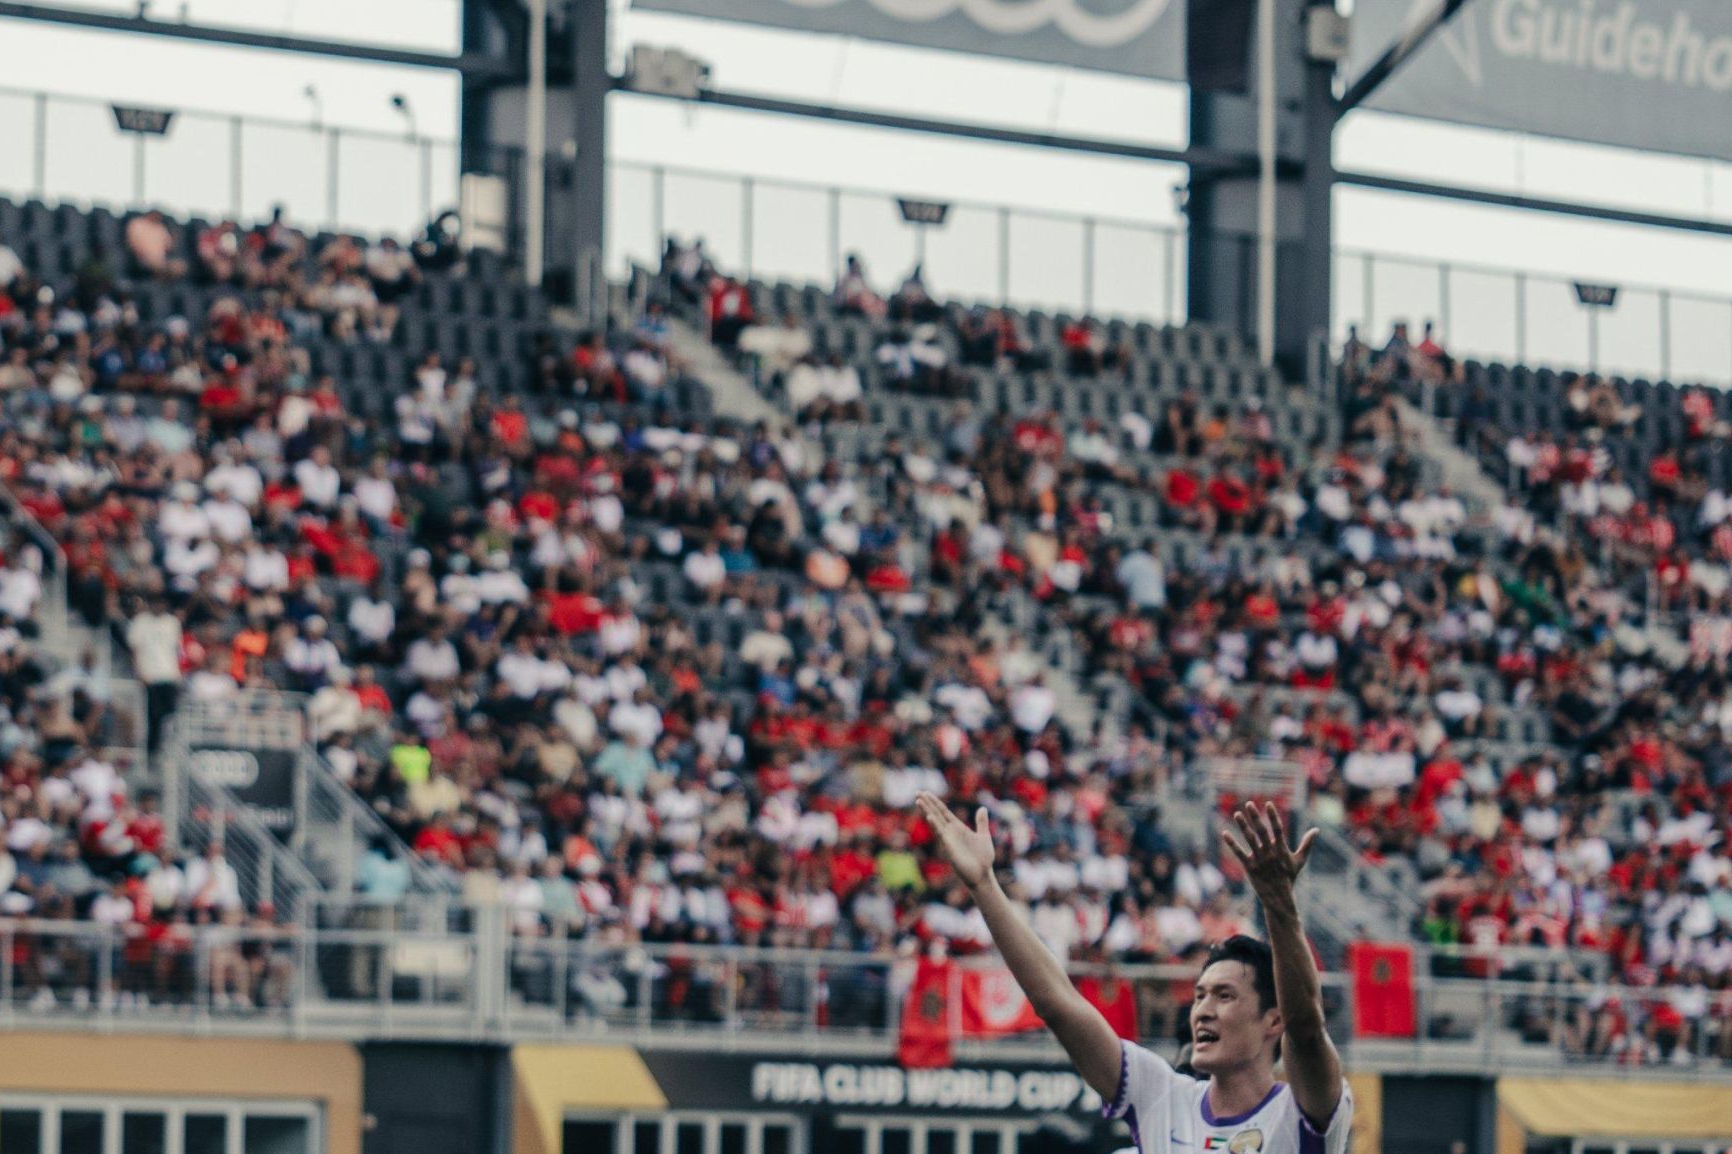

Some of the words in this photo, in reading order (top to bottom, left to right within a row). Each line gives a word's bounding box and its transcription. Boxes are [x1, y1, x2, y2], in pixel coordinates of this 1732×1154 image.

[752, 1062, 821, 1102] FIFA
[823, 1064, 905, 1105] CLUB
[907, 1069, 1016, 1109] WORLD
[1018, 1071, 1082, 1110] CUP
